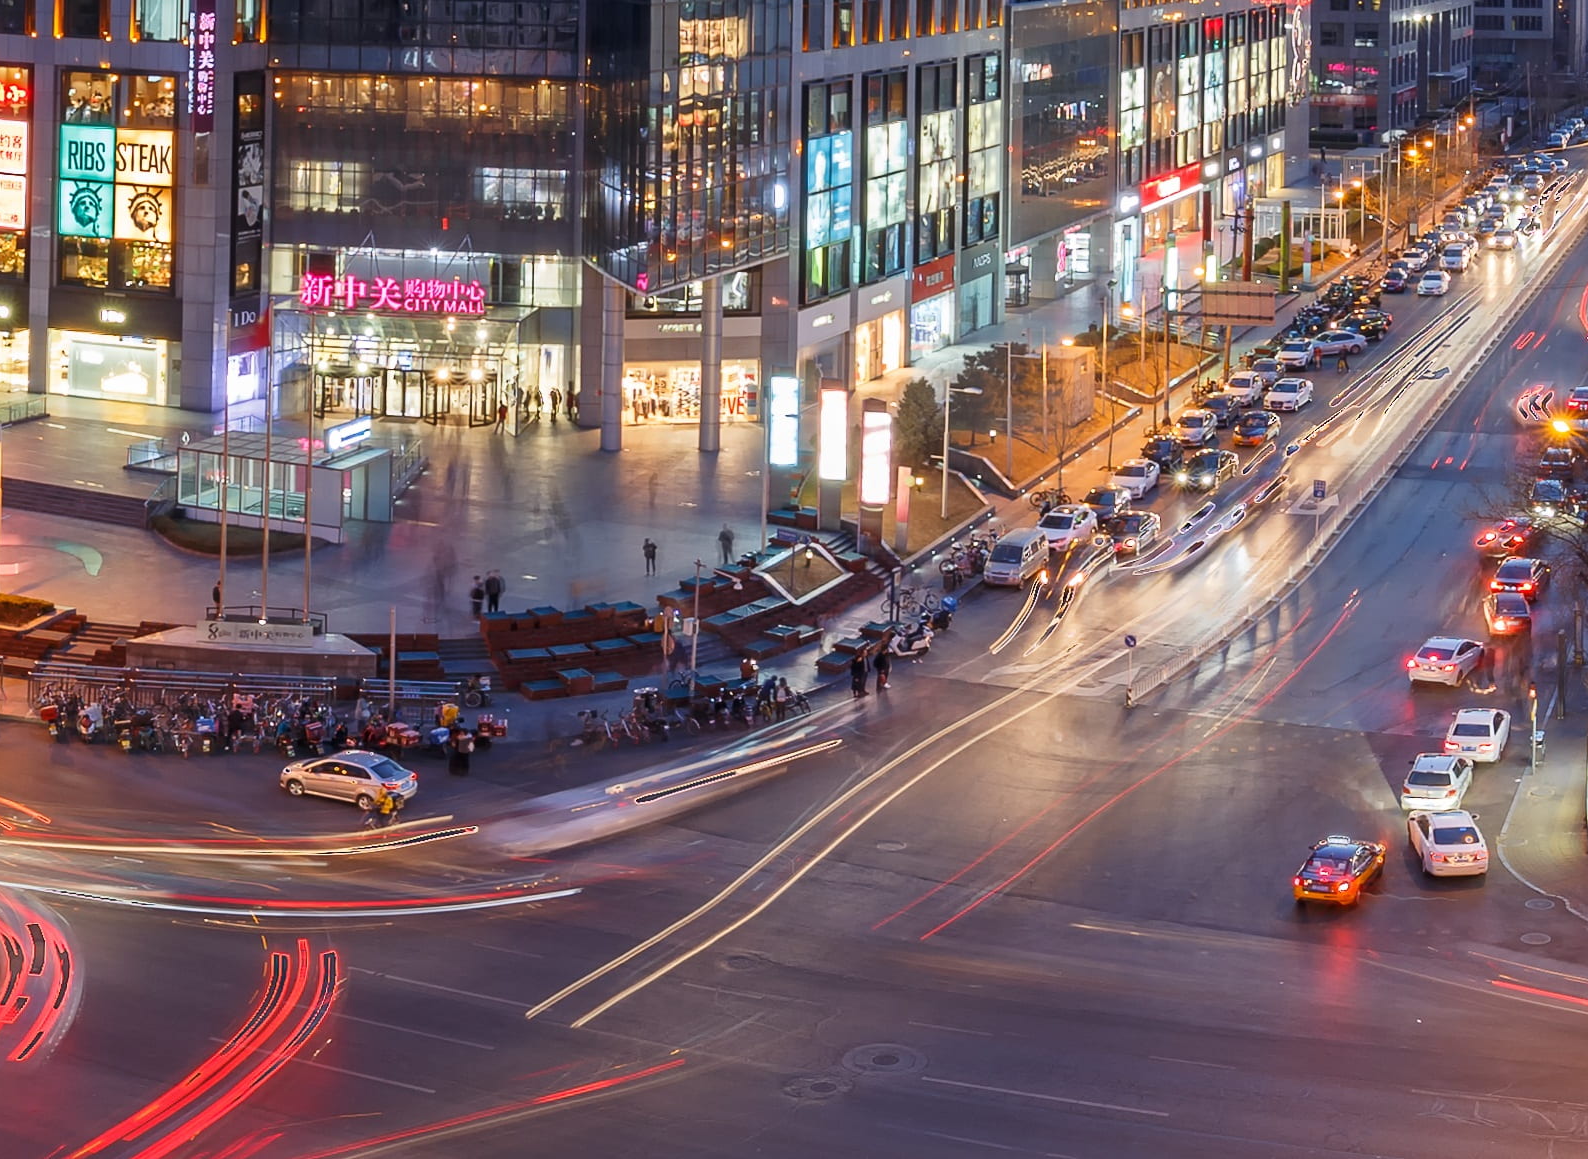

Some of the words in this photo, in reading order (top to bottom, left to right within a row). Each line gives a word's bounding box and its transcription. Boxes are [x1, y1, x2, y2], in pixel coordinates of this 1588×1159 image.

[67, 141, 105, 172] RIBS
[116, 142, 172, 174] STEAK
[403, 297, 439, 312] CITY
[442, 299, 485, 313] MALL
[234, 311, 240, 327] I
[240, 310, 257, 326] Do
